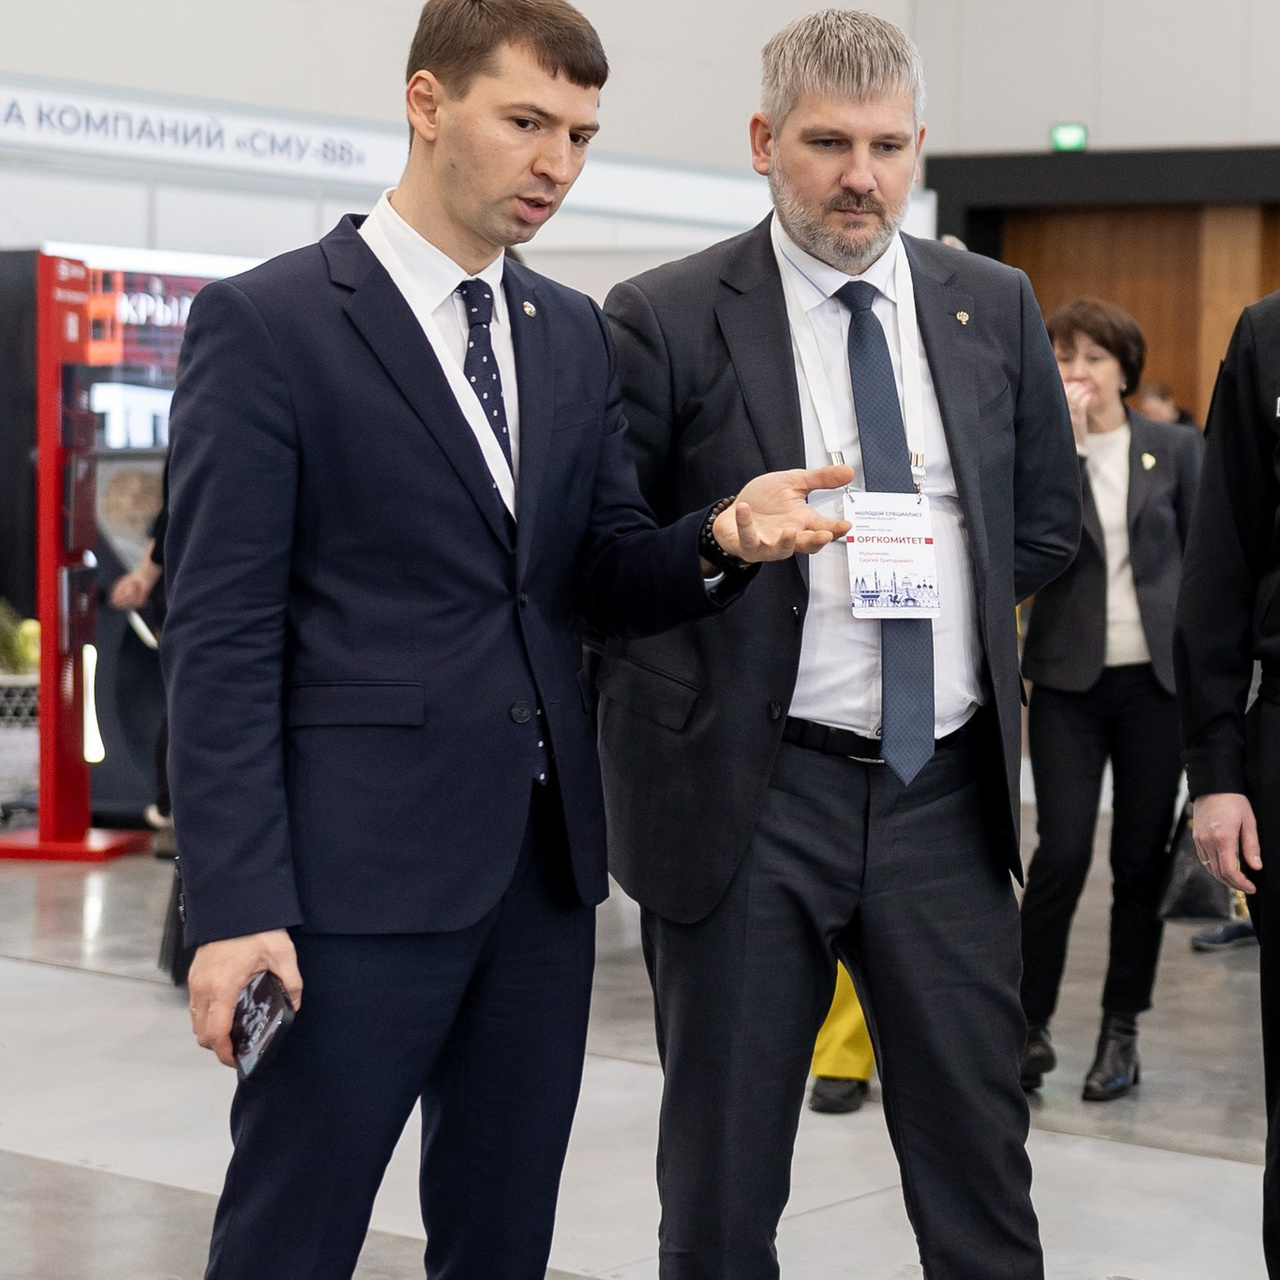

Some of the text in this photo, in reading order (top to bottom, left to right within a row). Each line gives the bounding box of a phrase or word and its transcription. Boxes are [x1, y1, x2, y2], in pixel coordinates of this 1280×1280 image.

[37, 103, 225, 150] КОМПАНИЙ
[235, 128, 367, 165] «СМУ-88»
[857, 536, 922, 544] ОРГКОМИТЕТ
